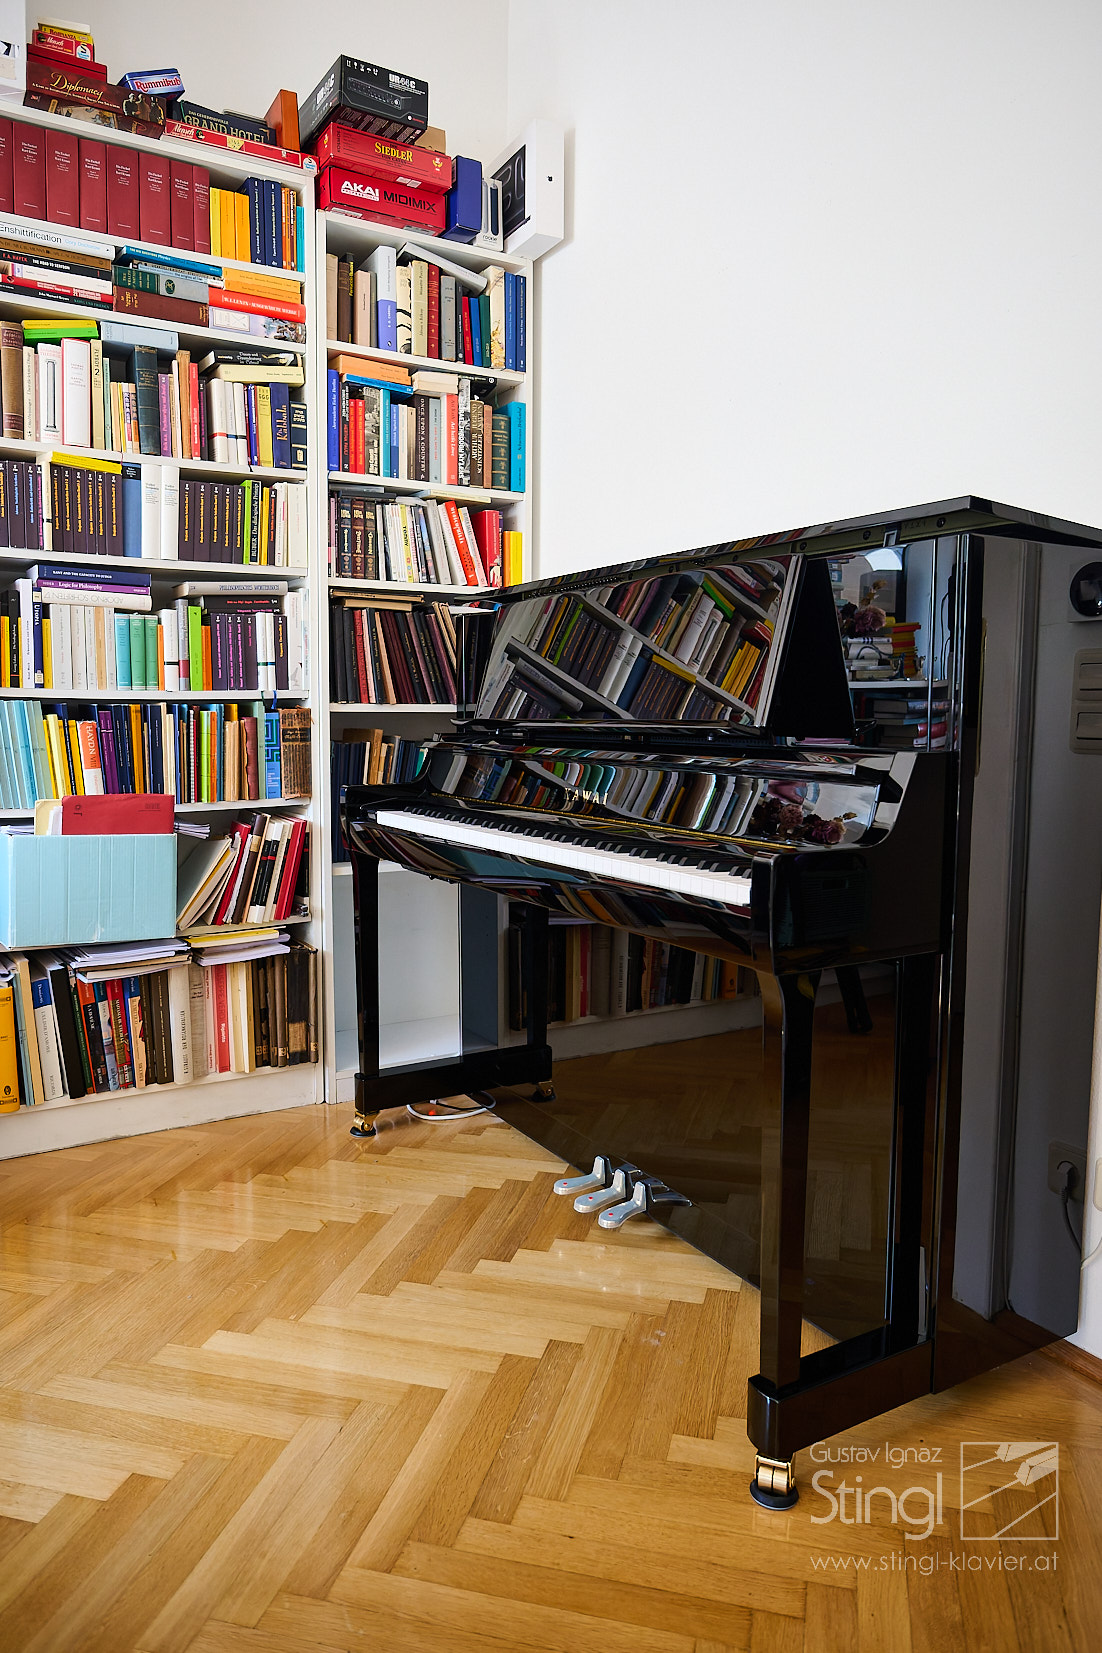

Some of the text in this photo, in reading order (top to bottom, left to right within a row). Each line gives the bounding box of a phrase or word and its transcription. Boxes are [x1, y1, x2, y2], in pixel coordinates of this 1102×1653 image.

[50, 72, 104, 102] Diplomacy
[134, 76, 181, 92] Rummikub
[184, 114, 227, 135] GRAND
[374, 142, 414, 162] SIEDLER
[341, 180, 379, 198] AKAI
[384, 190, 436, 213] MIDIMIX
[0, 226, 62, 243] Enshittification
[276, 404, 288, 441] Kabbala
[86, 725, 96, 755] HAYDN
